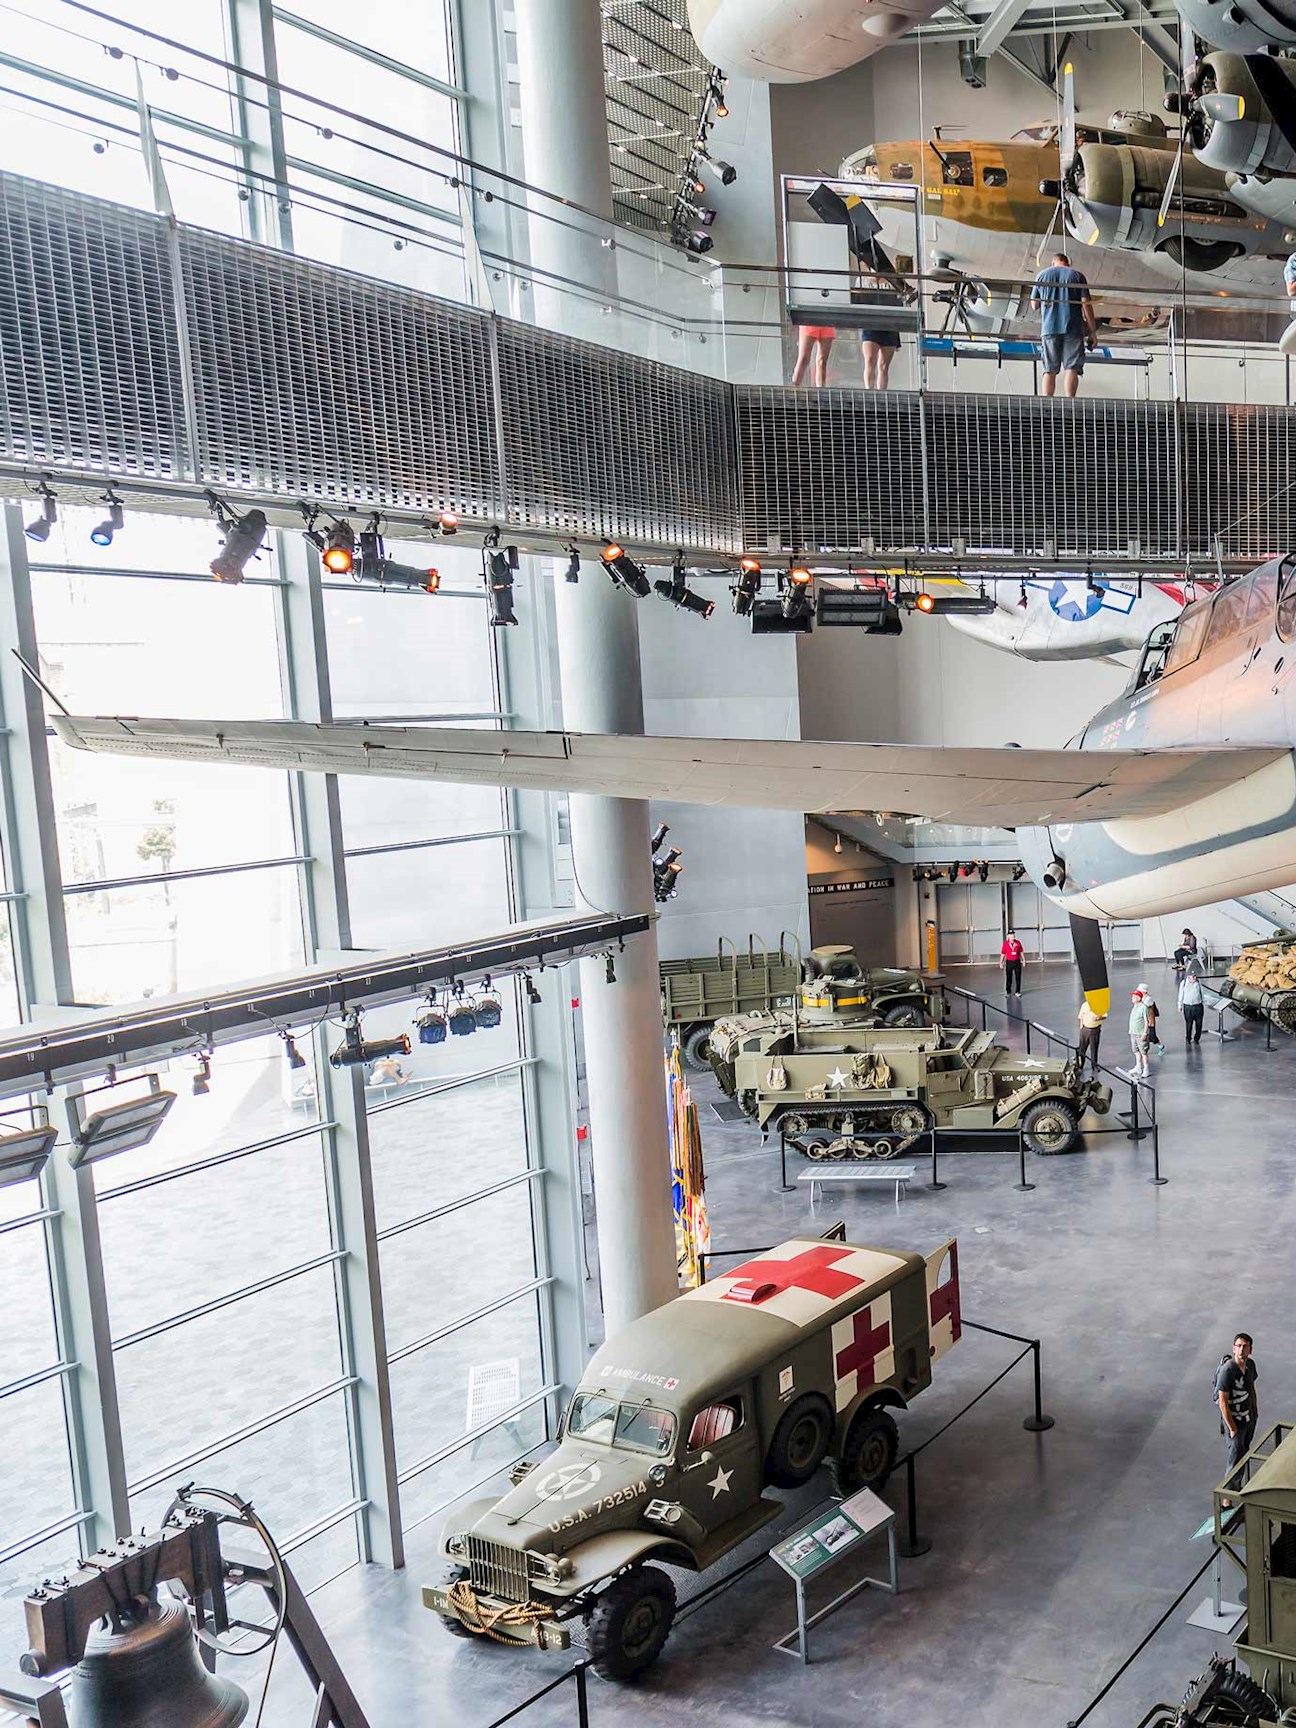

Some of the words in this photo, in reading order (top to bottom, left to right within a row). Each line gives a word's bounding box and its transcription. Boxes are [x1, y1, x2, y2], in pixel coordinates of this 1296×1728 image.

[836, 883, 851, 891] WAR
[853, 882, 866, 890] AND
[868, 880, 889, 888] PEACE
[611, 1367, 666, 1386] AMBULANCE
[548, 1508, 592, 1533] U.S.A.
[593, 1480, 647, 1514] 732514
